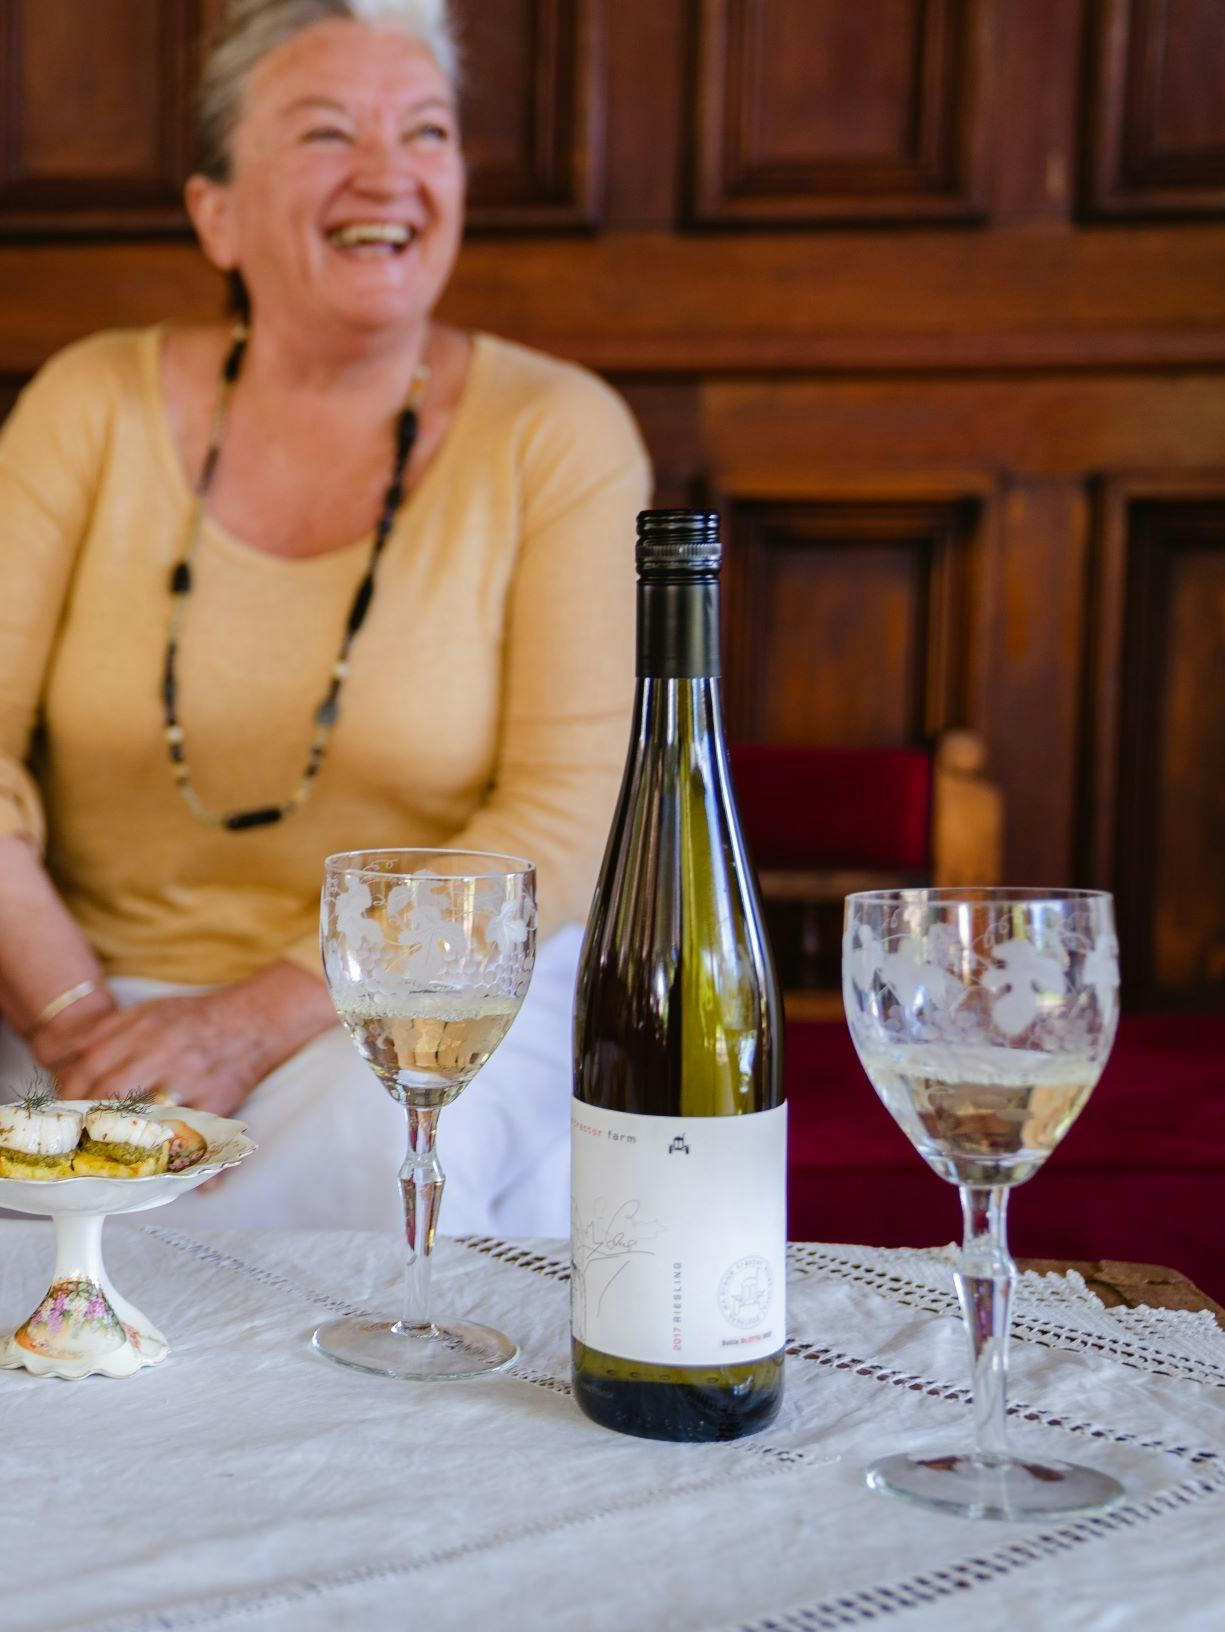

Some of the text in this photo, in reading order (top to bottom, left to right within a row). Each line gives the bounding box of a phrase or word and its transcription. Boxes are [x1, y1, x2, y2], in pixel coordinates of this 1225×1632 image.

[608, 1130, 636, 1144] farm
[673, 1262, 682, 1351] 2017 RIESLING
